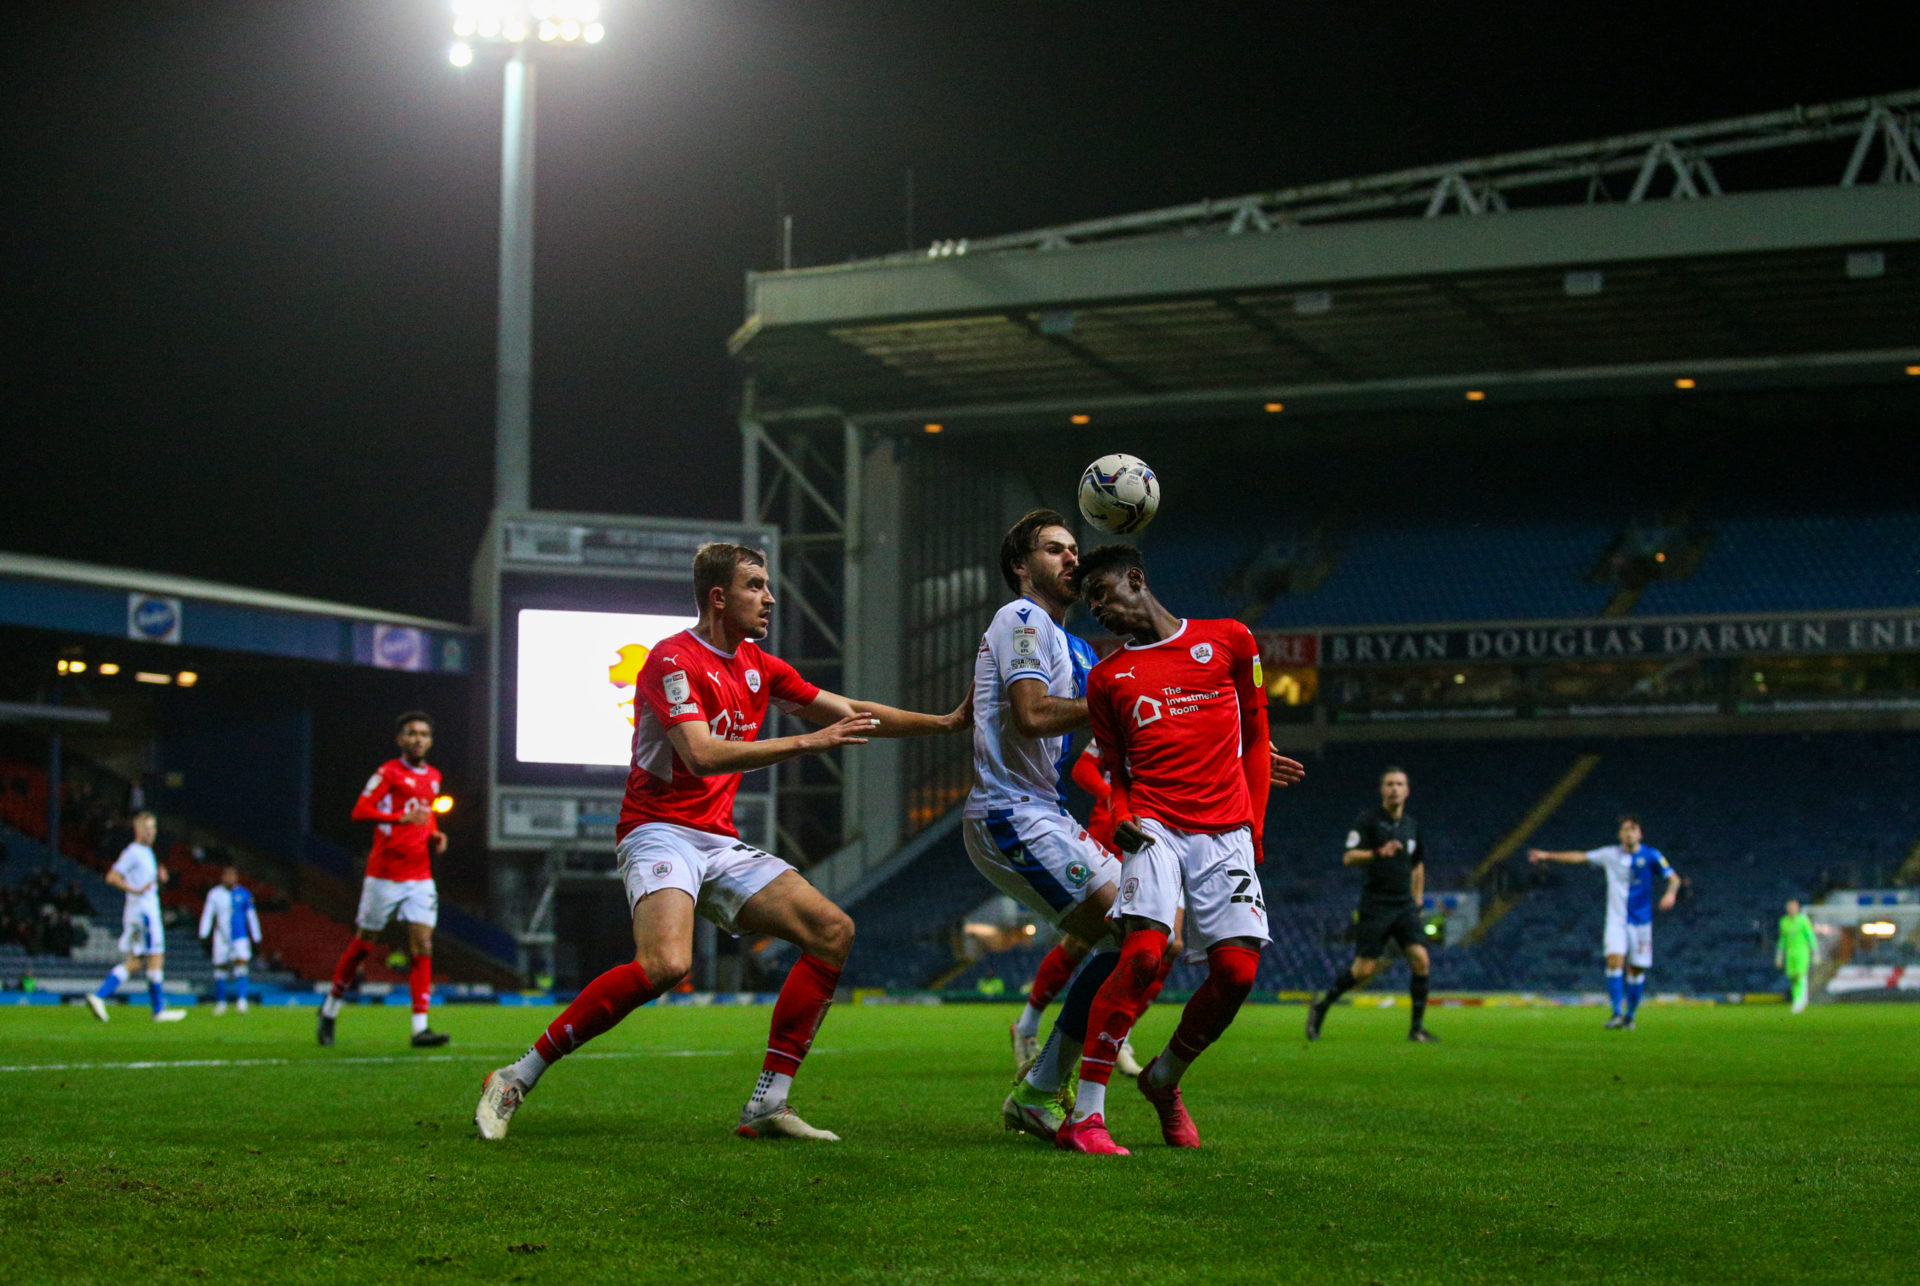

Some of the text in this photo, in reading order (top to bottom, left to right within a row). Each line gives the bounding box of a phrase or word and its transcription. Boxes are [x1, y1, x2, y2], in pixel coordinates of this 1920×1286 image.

[1332, 634, 1449, 663] BRYAN
[1467, 627, 1644, 658] DOUGLAS
[1663, 621, 1828, 653] DARWEN
[1162, 686, 1182, 696] The
[1166, 691, 1219, 706] Investment
[1169, 704, 1199, 717] Room
